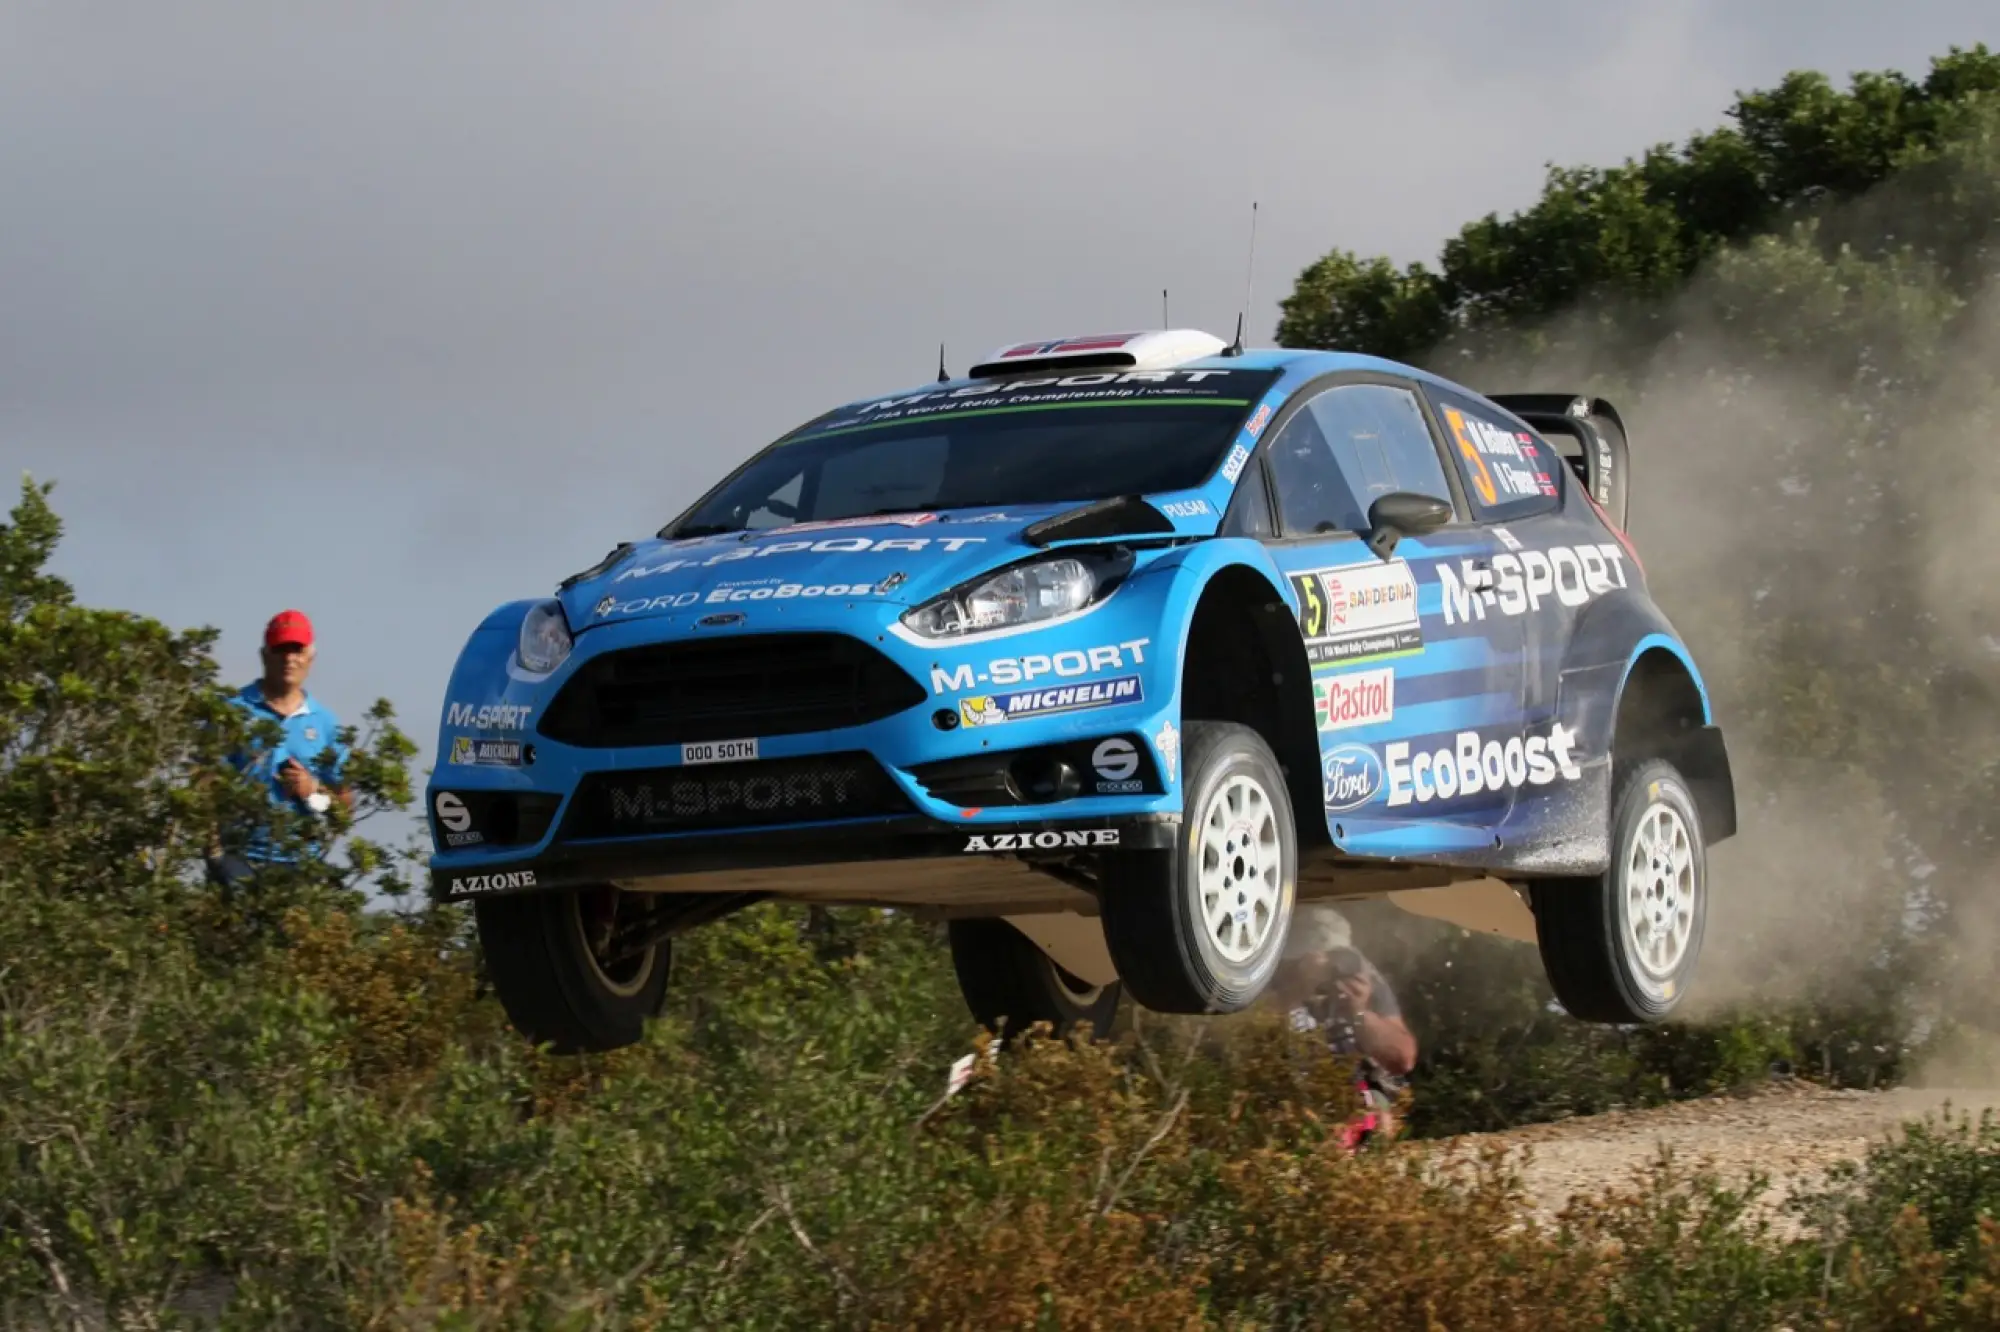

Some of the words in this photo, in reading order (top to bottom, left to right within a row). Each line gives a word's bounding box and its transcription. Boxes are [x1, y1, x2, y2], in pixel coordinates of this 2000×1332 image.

[907, 402, 958, 415] World
[960, 398, 1004, 409] Rally
[1009, 388, 1134, 404] Championship
[1444, 410, 1497, 505] 5
[1163, 499, 1210, 518] PULSAR
[612, 537, 987, 585] M-SPORT
[1301, 576, 1321, 637] 5
[1349, 583, 1413, 608] SARDEGNA
[1435, 544, 1628, 626] M-SPORT
[930, 638, 1150, 695] M-SPORT
[446, 701, 533, 731] M-SPORT
[1007, 679, 1138, 713] MICHELIN
[1330, 675, 1389, 723] Castrol
[1325, 756, 1371, 802] Ford
[1385, 722, 1582, 807] EcoBoost
[610, 768, 857, 820] M-SPORT
[963, 828, 1121, 852] AZIONE
[450, 870, 538, 895] AZIONE
